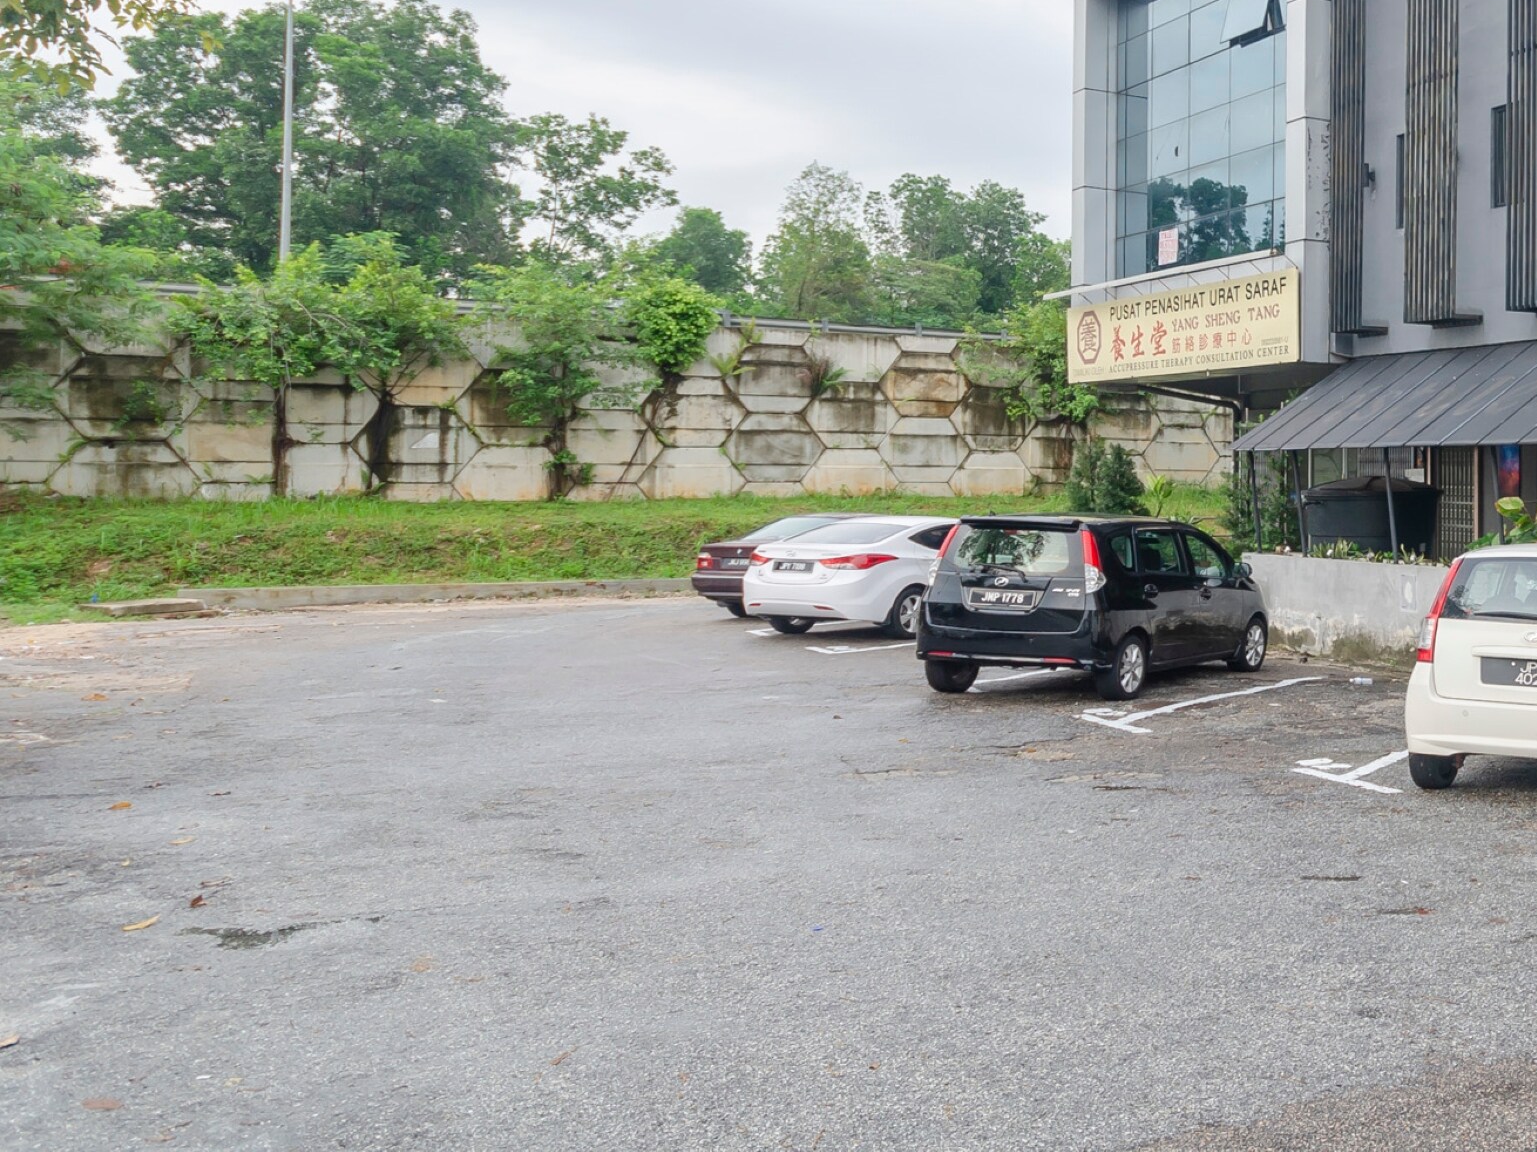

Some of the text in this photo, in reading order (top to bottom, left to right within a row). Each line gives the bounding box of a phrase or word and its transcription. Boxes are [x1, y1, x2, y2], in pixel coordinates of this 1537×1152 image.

[1110, 276, 1287, 322] PUSAT PENASIHAT URAT SARAF
[1172, 303, 1280, 332] YANG SHENG TANG
[1109, 345, 1289, 374] ACCUPRESSURE THERAPY CONSULTATION CENTER
[1001, 592, 1024, 604] 1778
